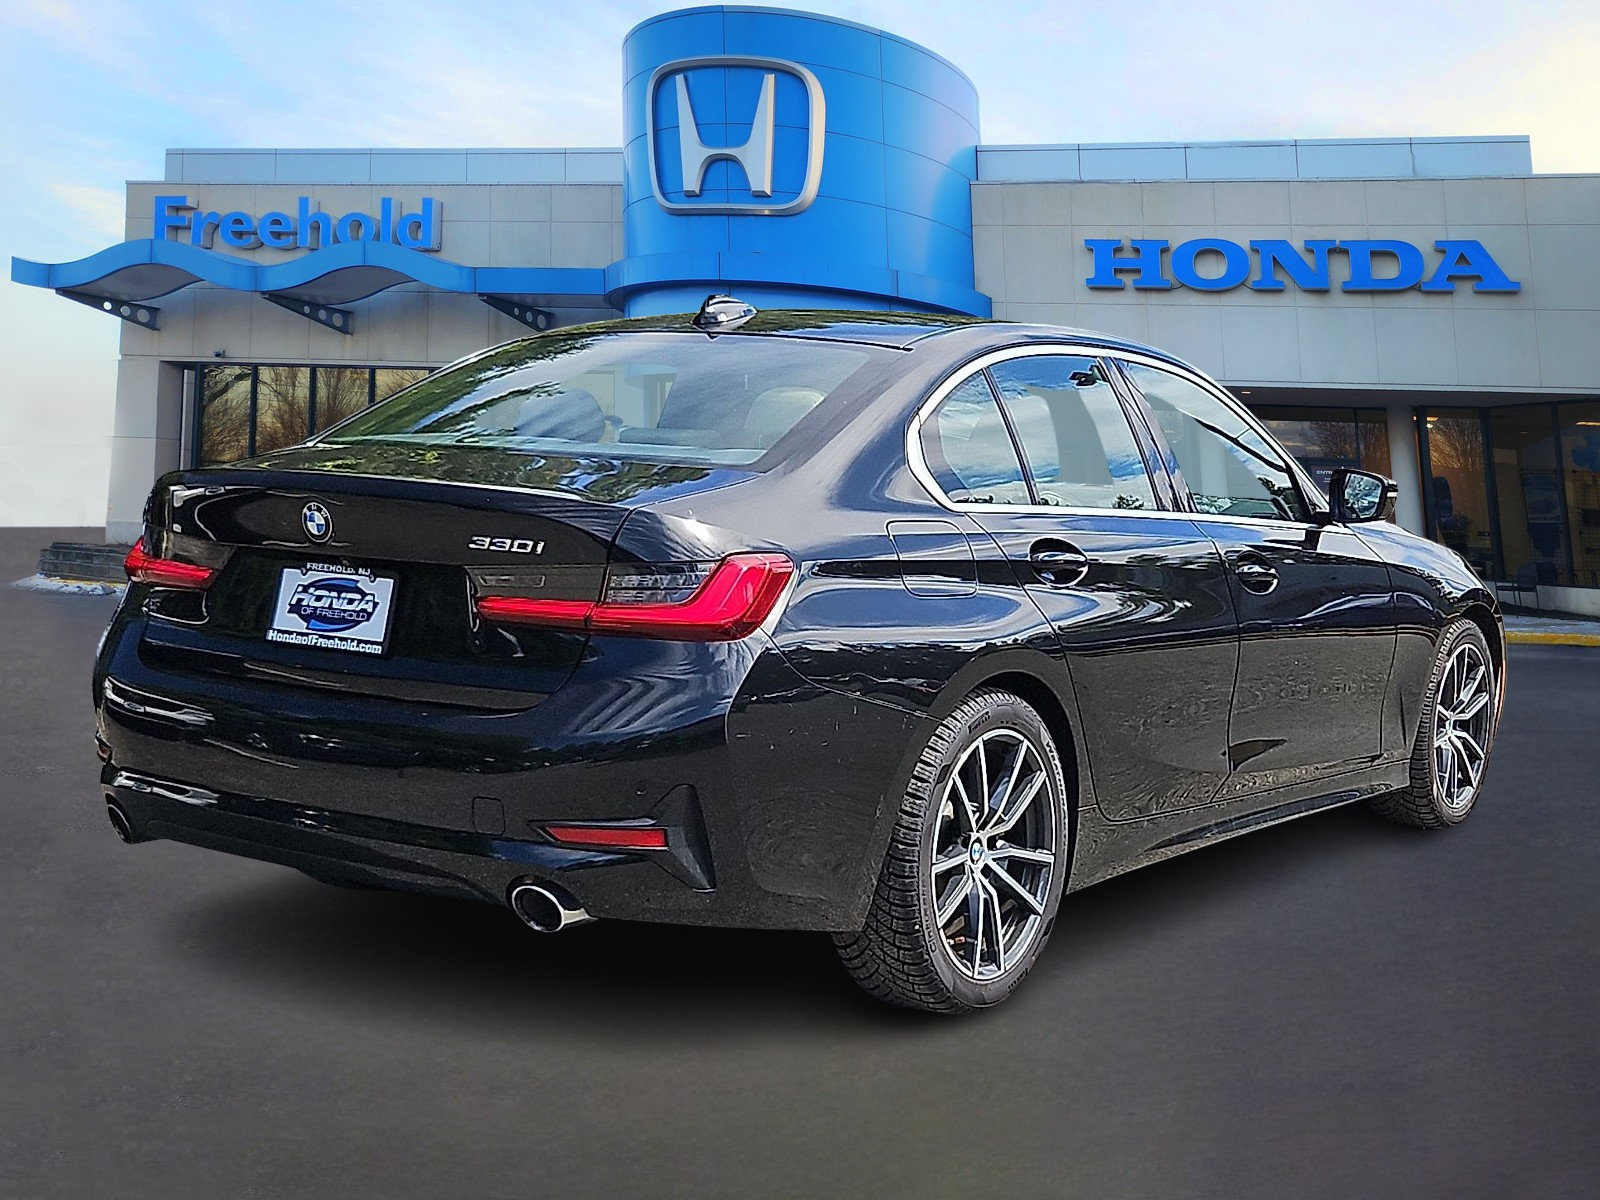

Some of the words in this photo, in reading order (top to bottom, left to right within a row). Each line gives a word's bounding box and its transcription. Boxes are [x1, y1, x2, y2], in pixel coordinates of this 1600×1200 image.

[153, 195, 438, 249] Freehold
[1084, 238, 1521, 293] HONDA
[468, 536, 545, 554] 330i
[358, 567, 370, 575] NJ
[290, 585, 374, 612] HONDA
[301, 606, 314, 615] OF
[316, 608, 367, 620] FREEHOLD
[266, 629, 382, 654] HondaofFreehold.com
